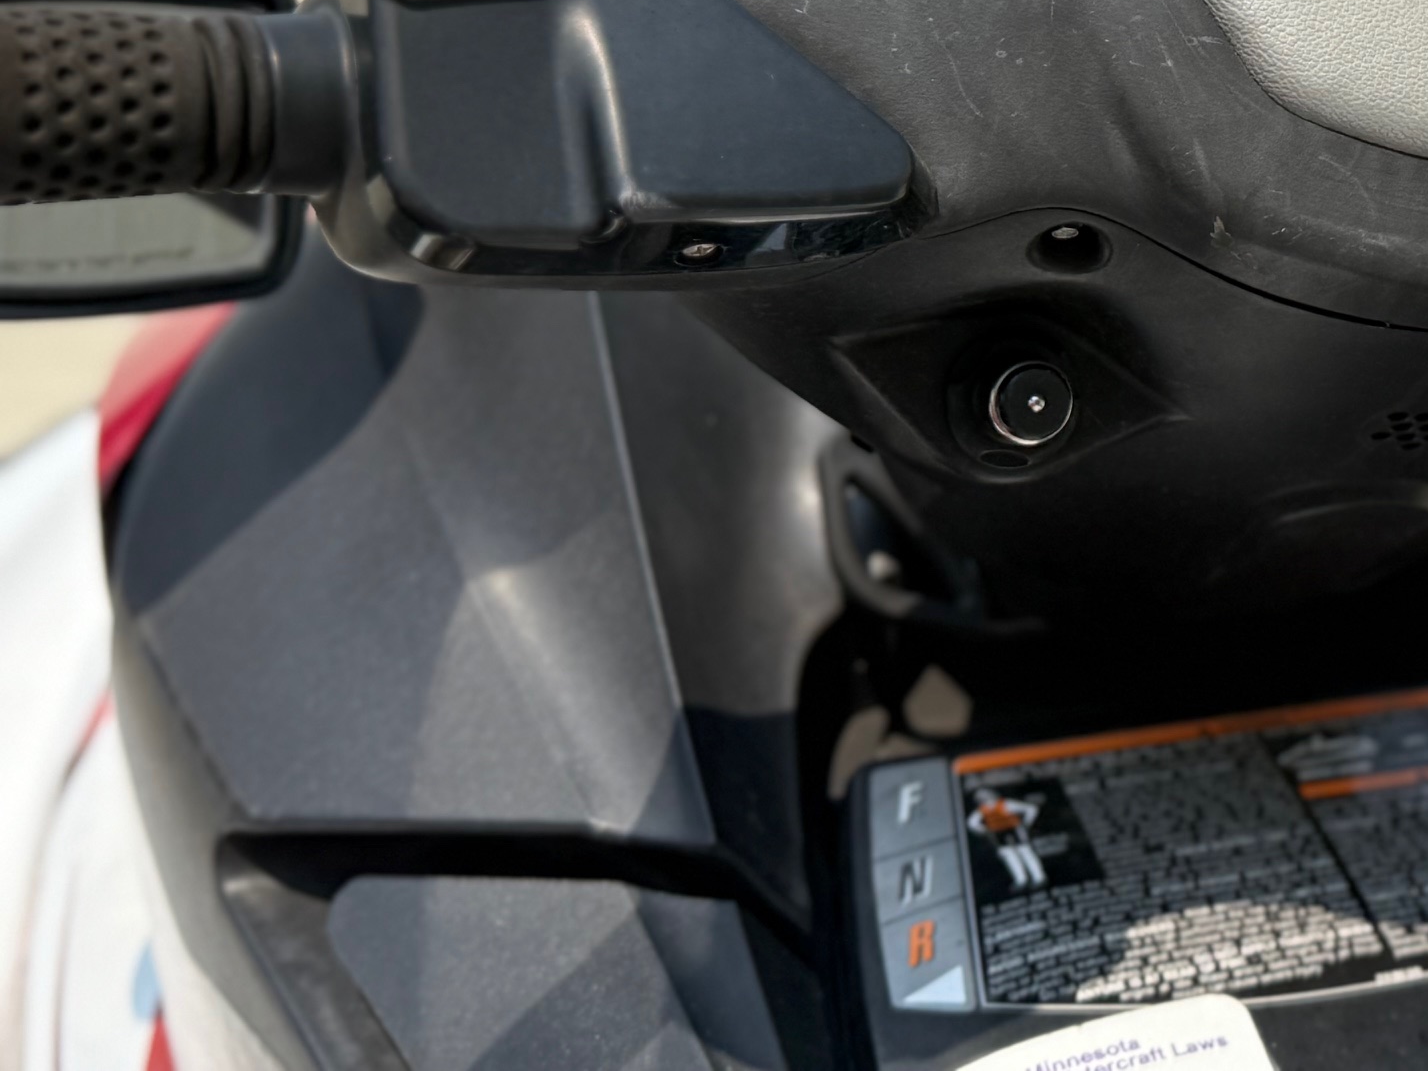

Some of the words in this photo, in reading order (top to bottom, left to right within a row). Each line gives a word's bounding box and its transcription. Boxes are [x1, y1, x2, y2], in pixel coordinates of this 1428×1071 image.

[897, 781, 922, 824] F
[900, 855, 932, 904] N
[907, 918, 935, 968] R
[1170, 1035, 1229, 1058] Laws
